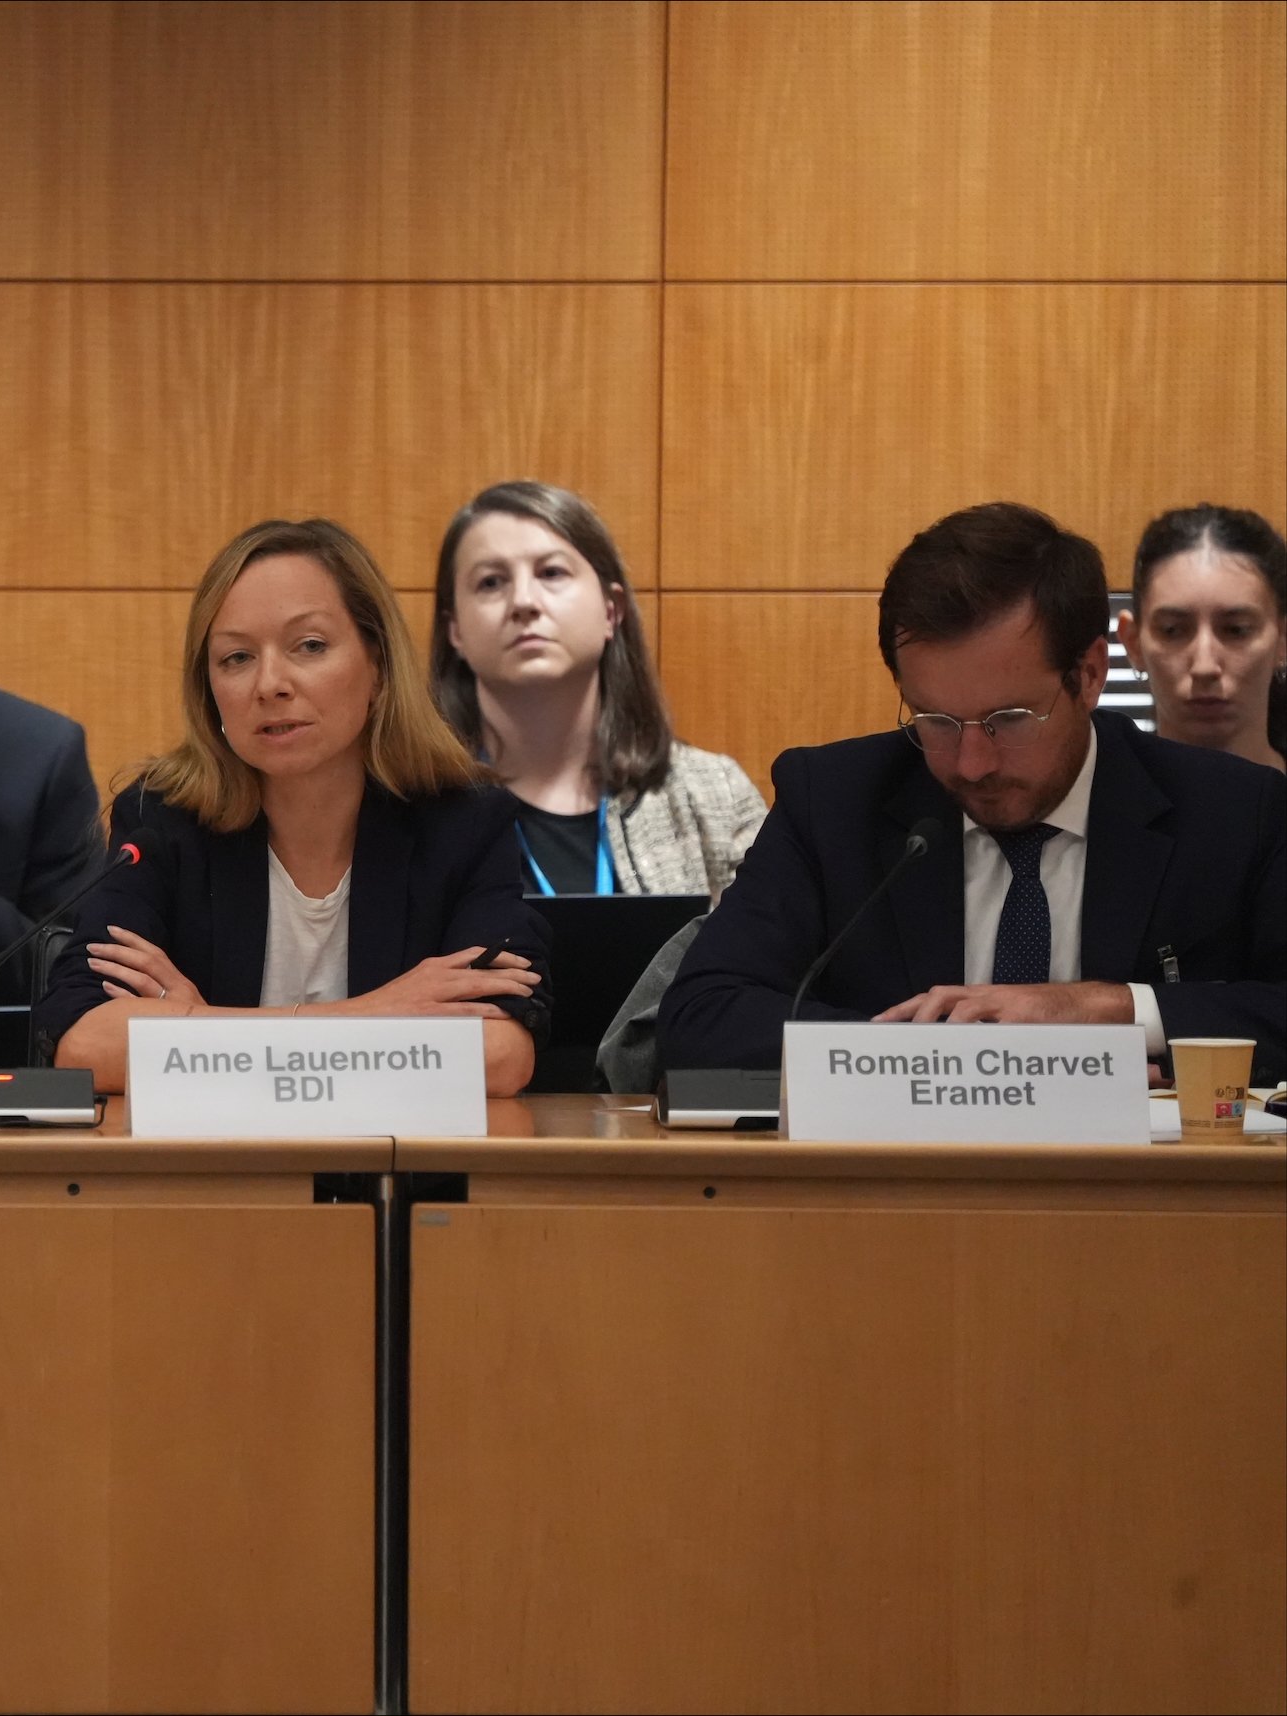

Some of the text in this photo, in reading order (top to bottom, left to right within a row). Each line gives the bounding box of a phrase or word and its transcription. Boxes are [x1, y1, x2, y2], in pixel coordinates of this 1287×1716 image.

[164, 1044, 442, 1073] Anne Lauenroth
[829, 1049, 1114, 1076] Romain Charvet
[274, 1076, 333, 1102] BDI
[911, 1080, 1036, 1106] Eramet
